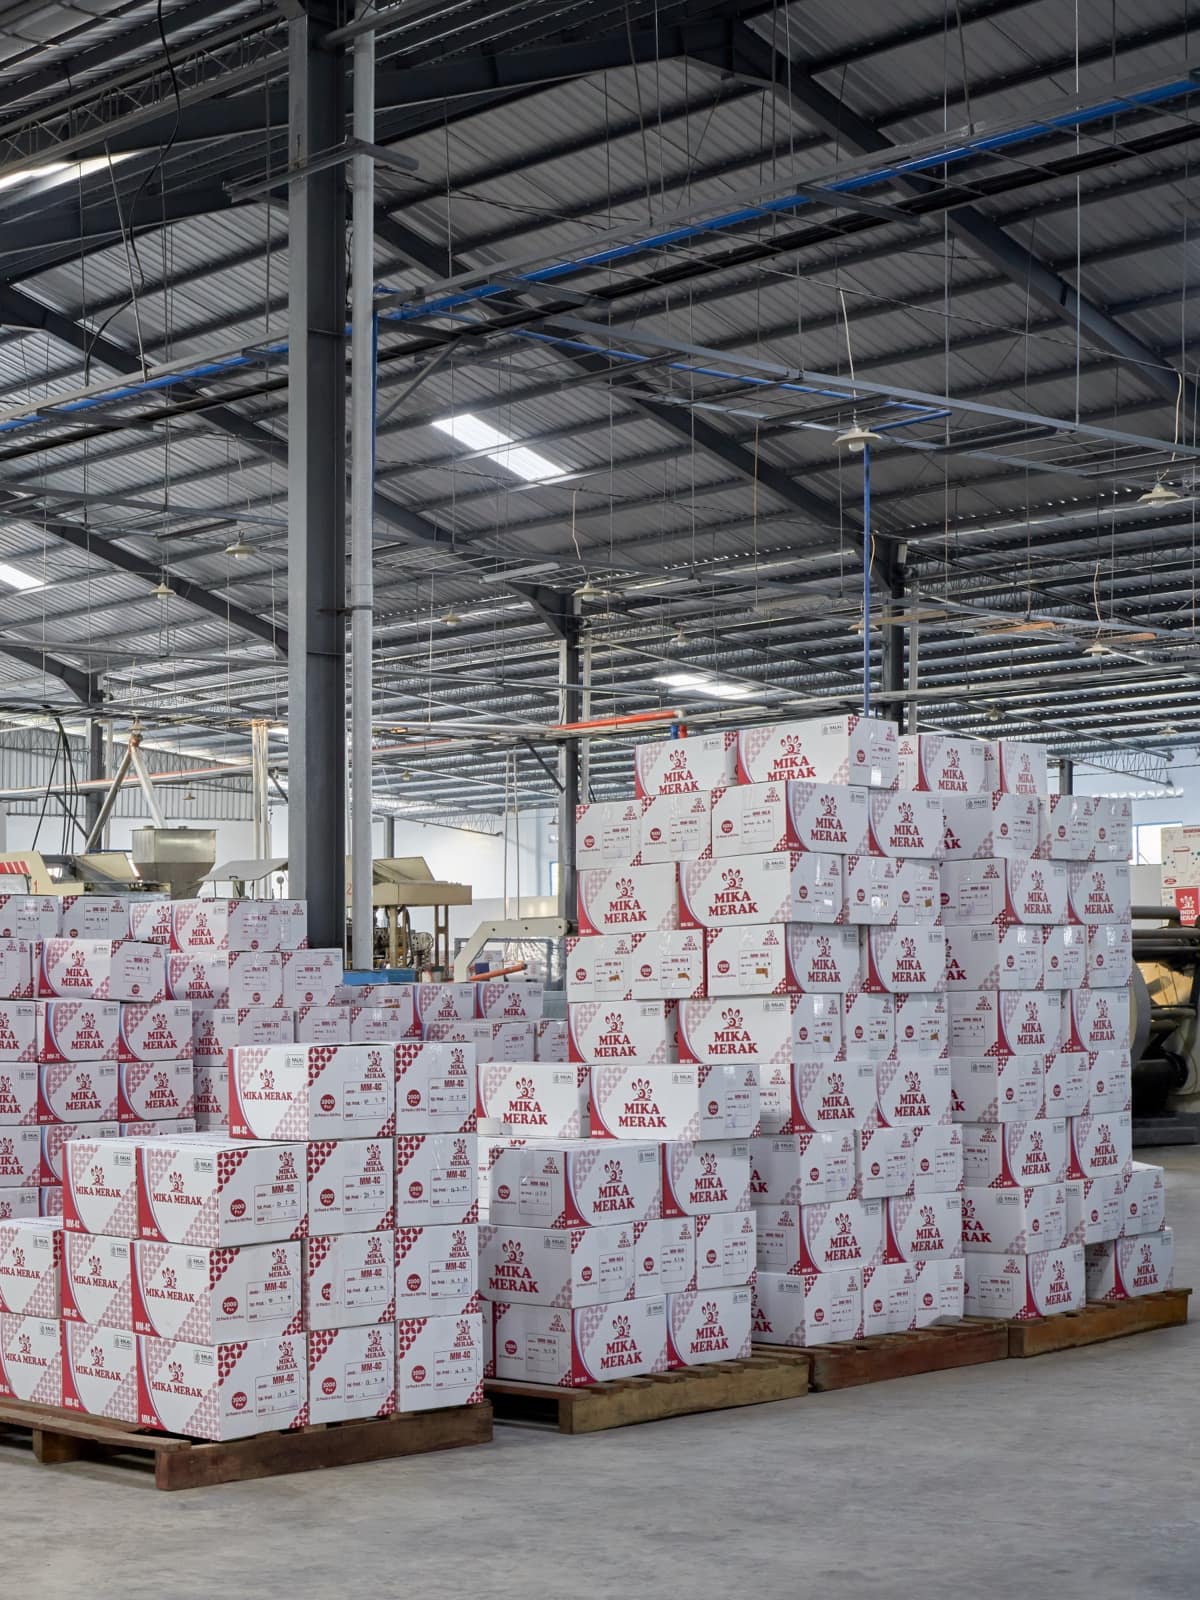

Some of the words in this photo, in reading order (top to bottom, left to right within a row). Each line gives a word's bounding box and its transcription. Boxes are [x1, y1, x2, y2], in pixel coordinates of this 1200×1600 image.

[773, 757, 810, 770] MIKA
[767, 768, 816, 782] MERAK
[942, 769, 964, 780] MIKA
[938, 780, 968, 792] MERAK
[815, 818, 843, 830] MIKA
[894, 824, 919, 836] MIKA
[810, 830, 847, 843] MERAK
[889, 836, 924, 848] MERAK
[714, 890, 750, 903] MIKA
[1089, 892, 1110, 903] MIKA
[609, 901, 641, 912] MIKA
[708, 902, 758, 916] MERAK
[1084, 902, 1114, 914] MERAK
[604, 911, 647, 924] MERAK
[896, 959, 921, 971] MIKA
[892, 971, 926, 983] MERAK
[714, 1032, 751, 1042] MIKA
[708, 1042, 758, 1054] MERAK
[360, 1082, 382, 1092] MM-4C
[444, 1079, 464, 1088] MM-4C
[149, 1089, 174, 1099] MIKA
[243, 1091, 263, 1100] MIKA
[265, 1091, 292, 1101] MERAK
[900, 1094, 926, 1105] MIKA
[145, 1097, 179, 1108] MERAK
[822, 1095, 850, 1108] MIKA
[624, 1103, 660, 1115] MIKA
[817, 1107, 855, 1120] MERAK
[894, 1105, 931, 1117] MERAK
[618, 1115, 667, 1128] MERAK
[359, 1176, 381, 1185] MM-4C
[694, 1177, 724, 1190] MIKA
[76, 1185, 97, 1197] MIKA
[98, 1187, 121, 1198] MERAK
[272, 1184, 294, 1194] MM-4C
[598, 1185, 630, 1198] MIKA
[153, 1191, 172, 1203] MIKA
[174, 1194, 202, 1206] MERAK
[689, 1189, 728, 1203] MERAK
[593, 1197, 635, 1212] MERAK
[830, 1235, 858, 1248] MIKA
[824, 1247, 862, 1262] MERAK
[495, 1265, 532, 1278] MIKA
[264, 1281, 287, 1291] MM-4C
[489, 1278, 539, 1293] MERAK
[145, 1287, 166, 1299] MIKA
[168, 1290, 195, 1302] MERAK
[696, 1327, 724, 1340] MIKA
[606, 1342, 637, 1355] MIKA
[690, 1338, 729, 1353] MERAK
[600, 1352, 642, 1368] MERAK
[272, 1375, 295, 1385] MM-4C
[152, 1381, 172, 1393] MIKA
[174, 1384, 202, 1397] MERAK
